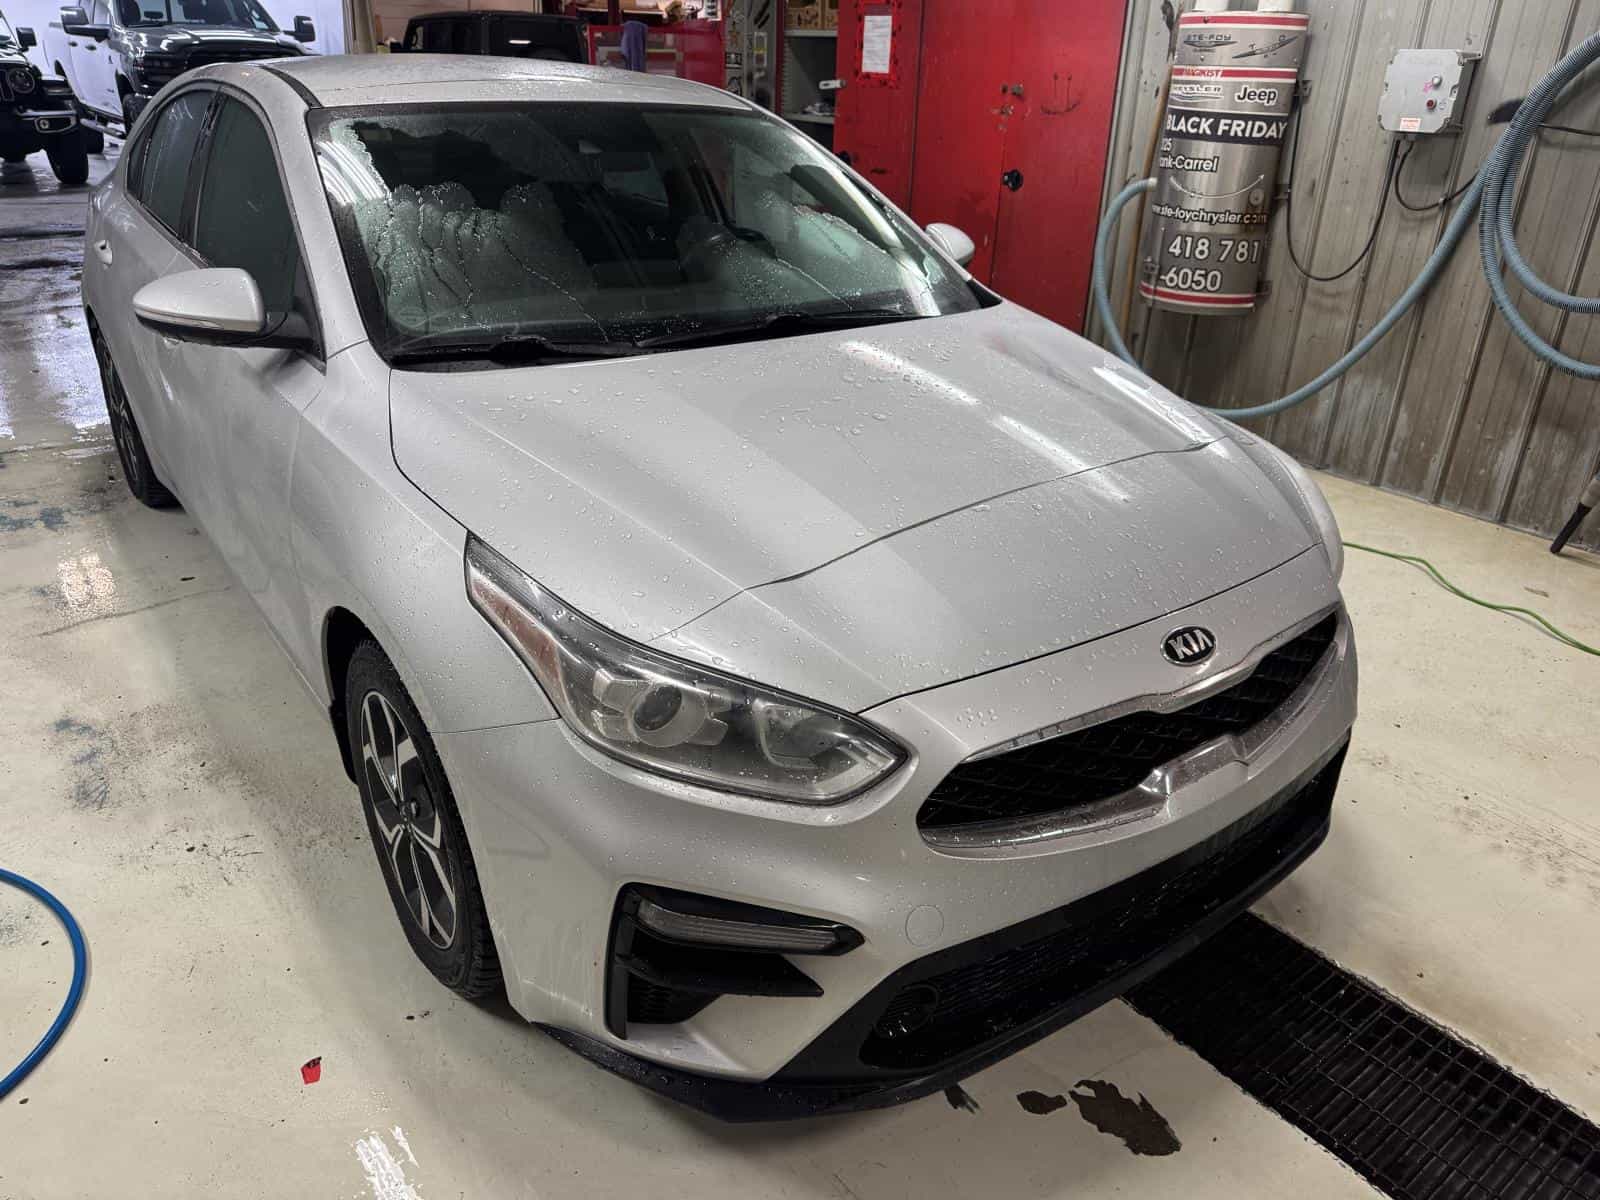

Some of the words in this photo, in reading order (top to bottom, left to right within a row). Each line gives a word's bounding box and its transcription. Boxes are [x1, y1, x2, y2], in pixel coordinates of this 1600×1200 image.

[1236, 86, 1277, 104] Jeep
[1166, 114, 1215, 135] BLACK
[1217, 119, 1288, 139] FRIDAY
[1168, 236, 1210, 260] 418
[1219, 240, 1259, 263] 781
[1160, 267, 1222, 291] -6050
[1168, 629, 1213, 660] KIA
